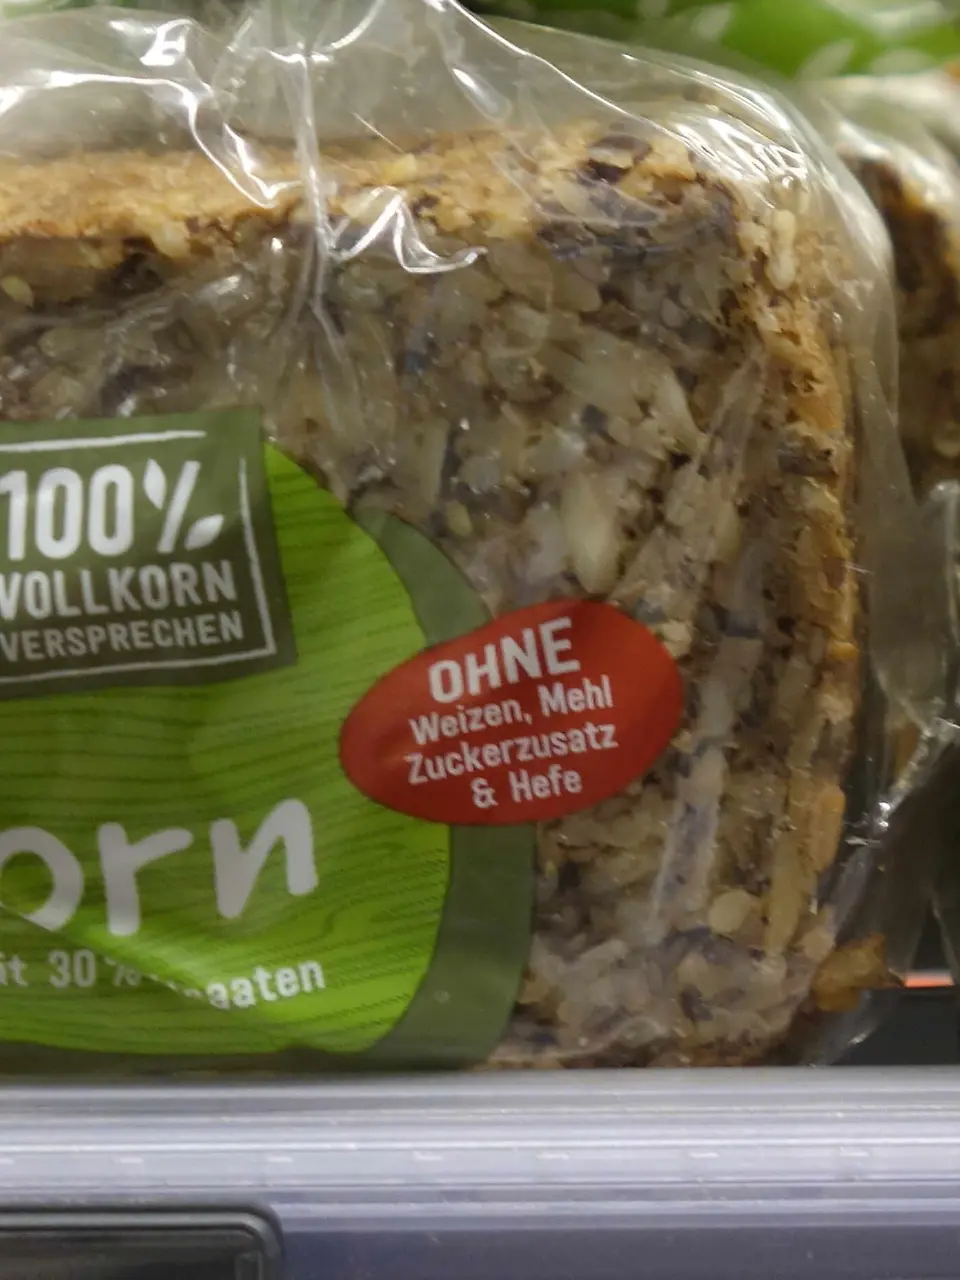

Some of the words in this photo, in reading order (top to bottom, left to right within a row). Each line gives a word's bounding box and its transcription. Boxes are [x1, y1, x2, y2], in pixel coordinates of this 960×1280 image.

[0, 458, 225, 561] 100%
[0, 560, 238, 621] VOLLKORN
[0, 610, 244, 662] VERSPRECHEN
[428, 616, 581, 704] OHNE
[408, 698, 533, 746] Weizen,
[537, 674, 613, 718] Mehl
[404, 721, 619, 785] Zuckerzusatz
[471, 776, 498, 809] &
[508, 764, 583, 803] Hefe
[48, 948, 97, 989] 30
